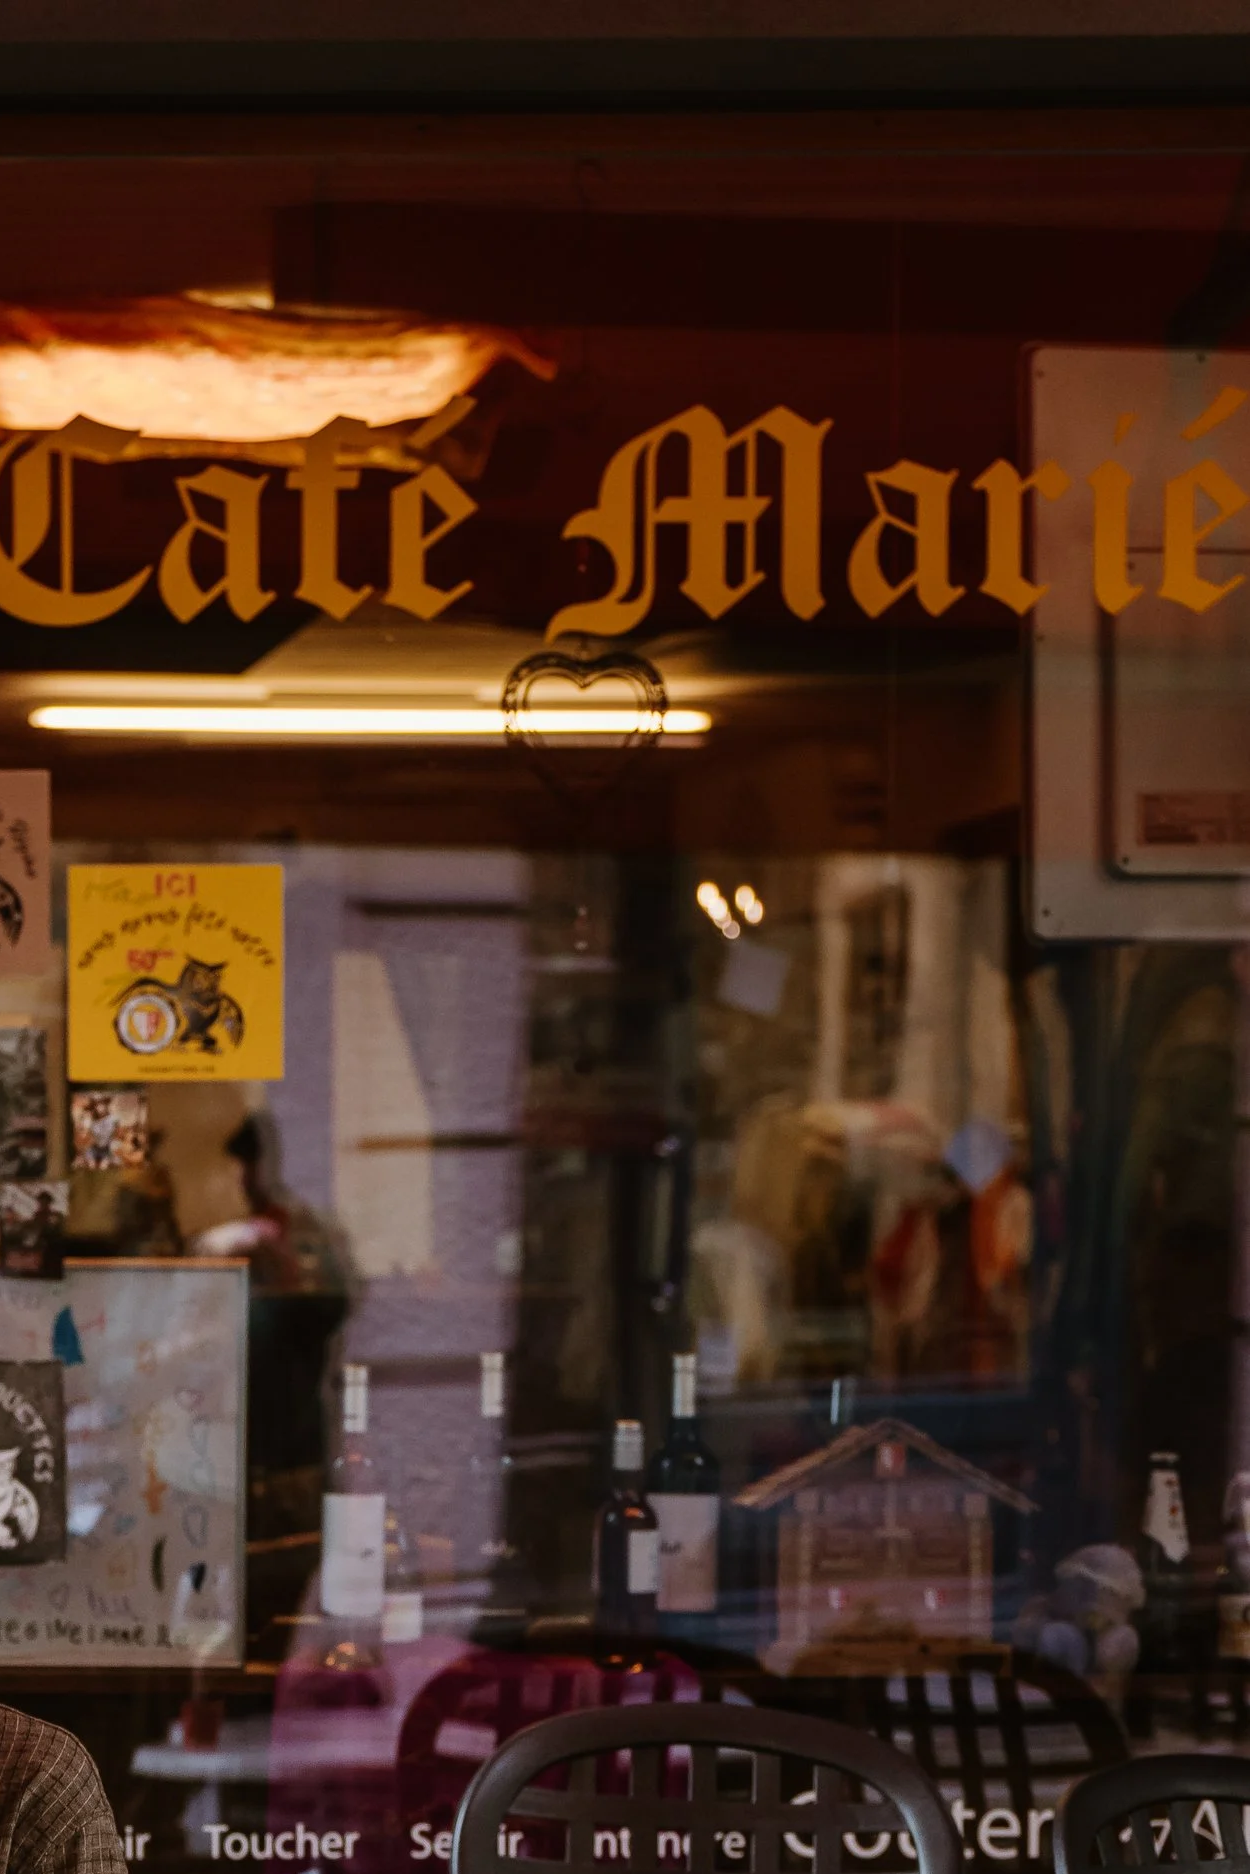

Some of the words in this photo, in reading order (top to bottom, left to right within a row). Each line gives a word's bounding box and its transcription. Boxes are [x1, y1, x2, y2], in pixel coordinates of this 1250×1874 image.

[544, 386, 1250, 643] Marié
[155, 872, 196, 897] ICI
[202, 1822, 360, 1860] Toucher
[410, 1822, 525, 1860] Seir
